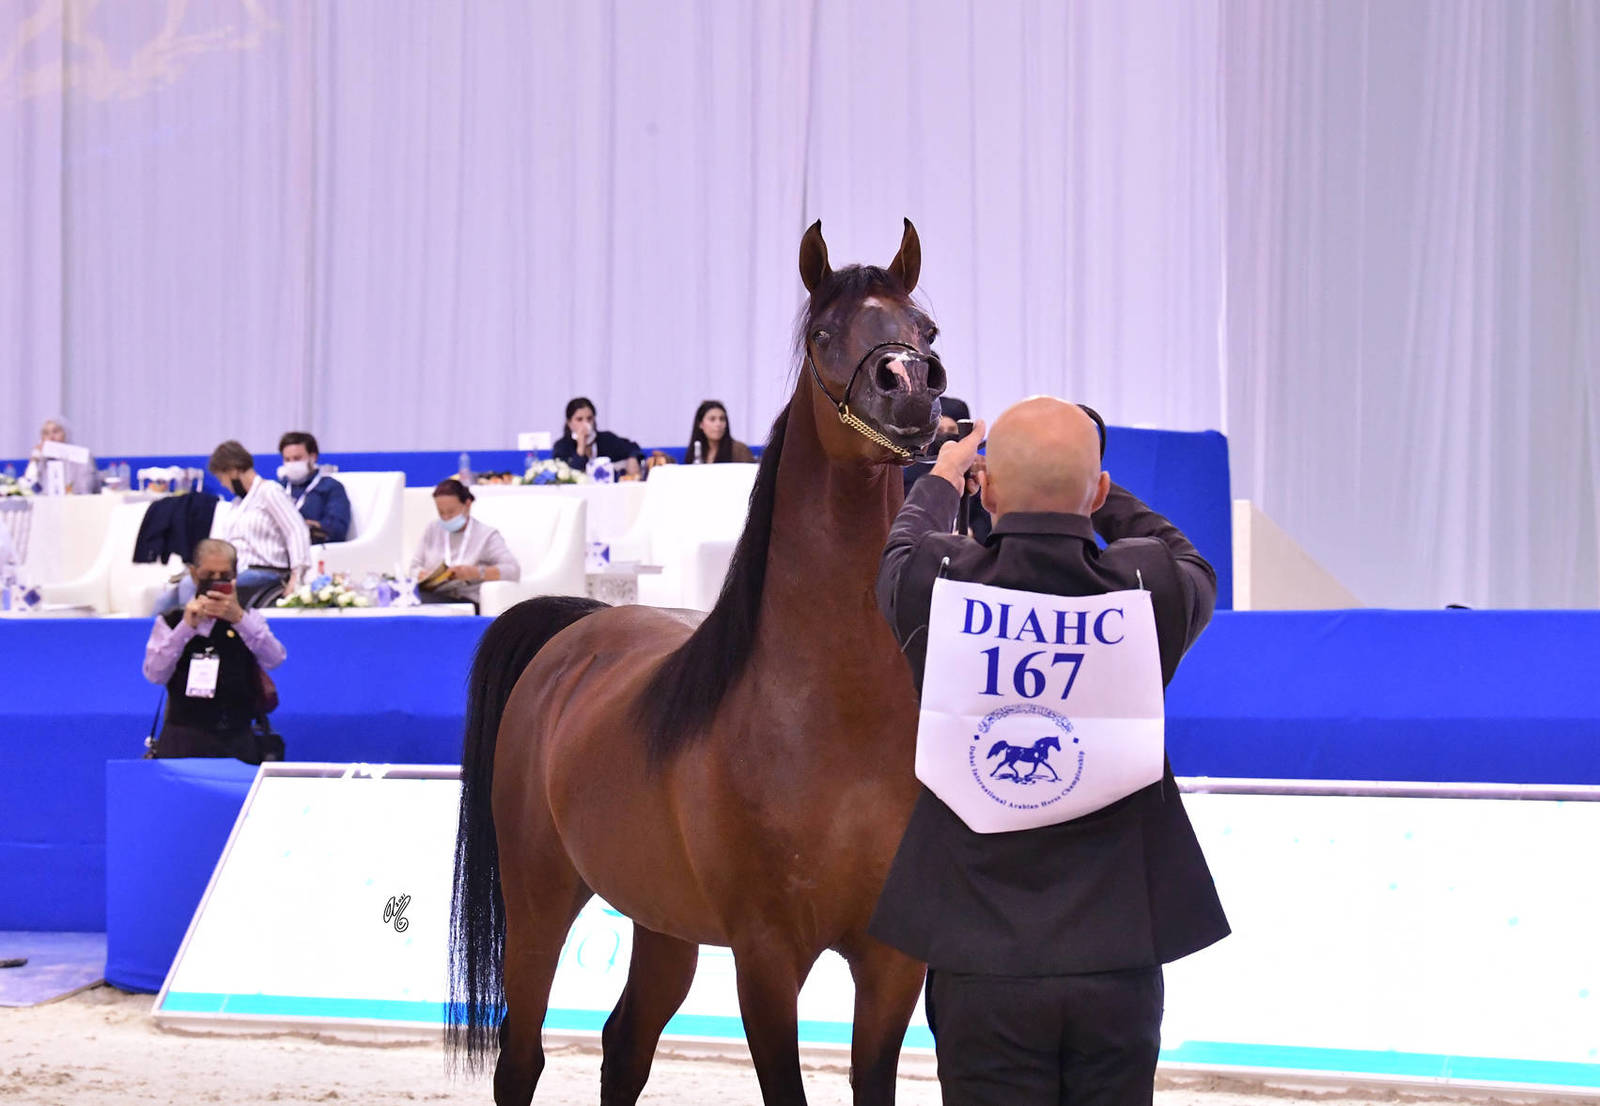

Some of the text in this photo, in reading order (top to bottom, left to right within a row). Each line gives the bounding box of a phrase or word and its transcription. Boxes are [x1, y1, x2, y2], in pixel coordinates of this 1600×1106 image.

[961, 598, 1125, 645] DIAHC
[979, 646, 1085, 700] 167
[969, 745, 977, 767] Dubai
[1061, 750, 1086, 796] Championship
[971, 768, 1007, 805] International
[1041, 796, 1061, 807] Horse
